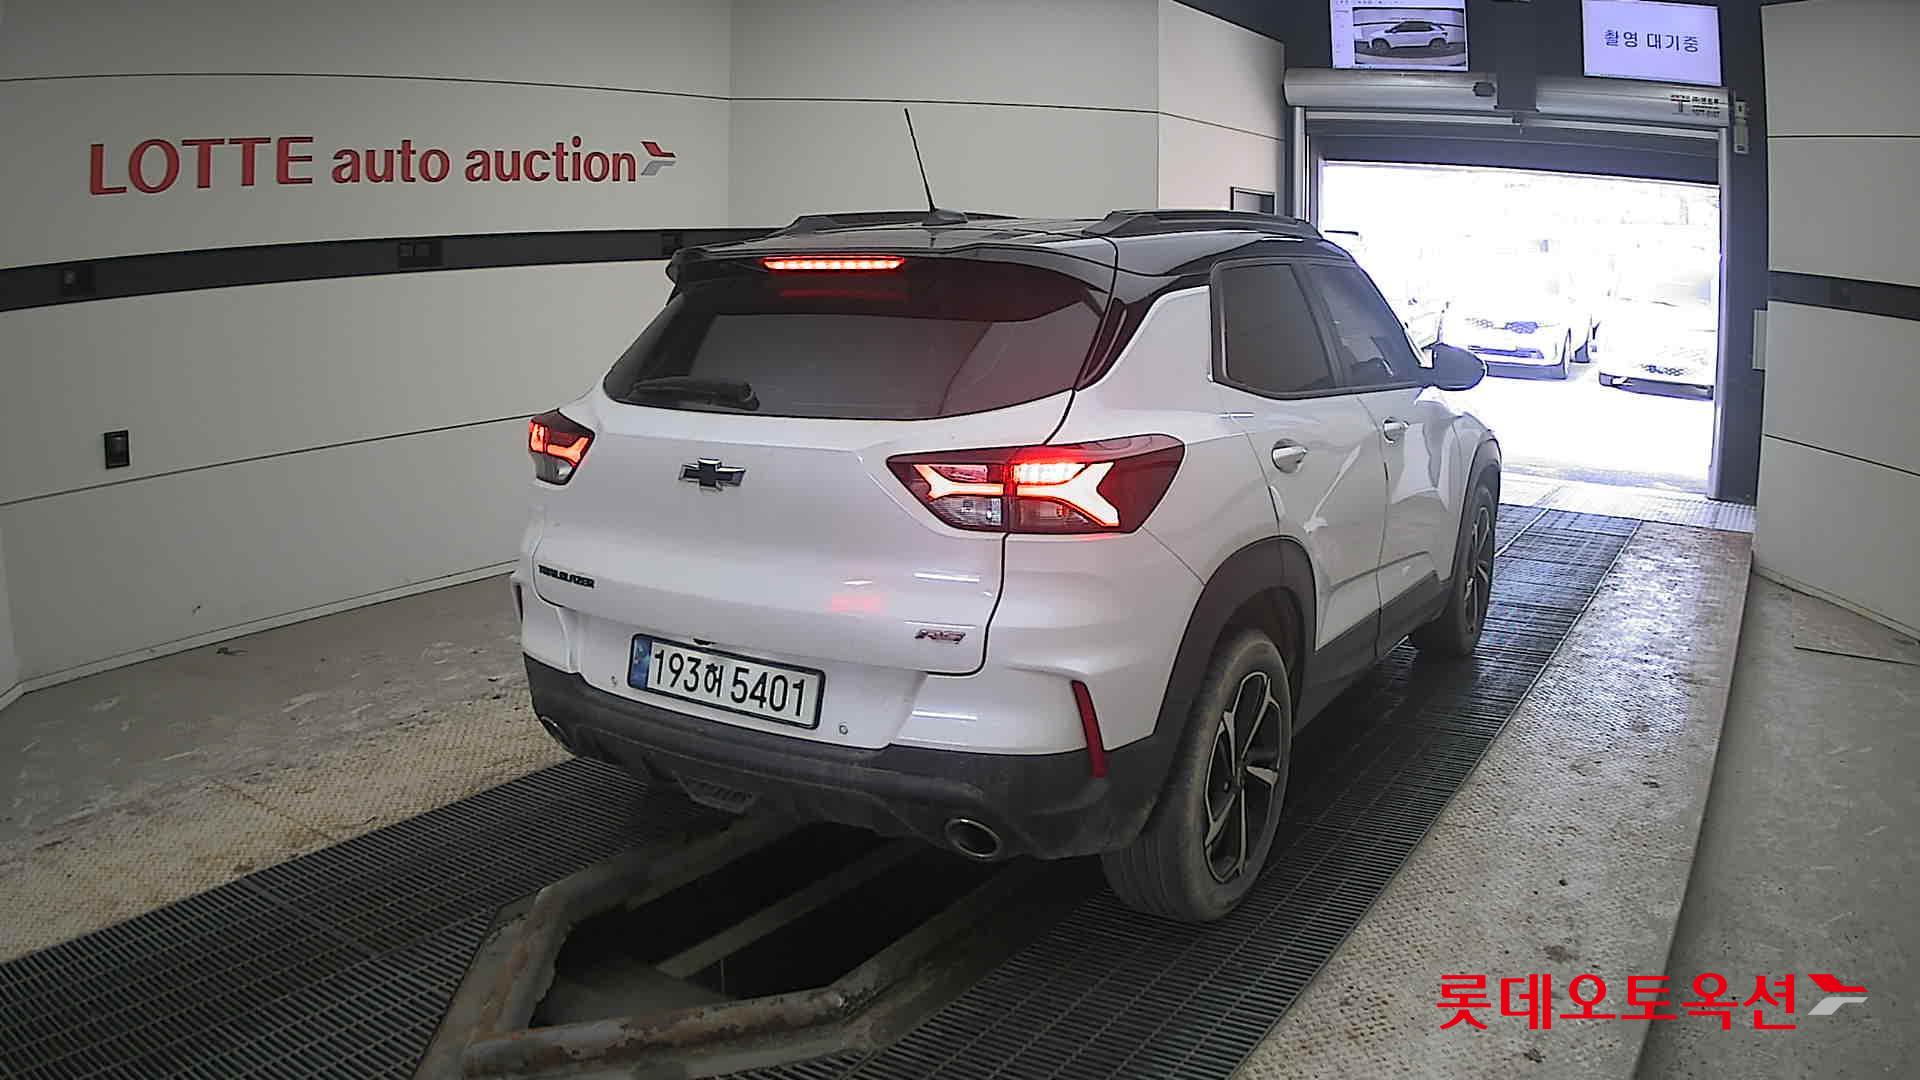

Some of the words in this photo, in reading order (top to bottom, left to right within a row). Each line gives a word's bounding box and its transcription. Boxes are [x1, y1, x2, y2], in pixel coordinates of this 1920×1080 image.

[1646, 33, 1699, 53] 대기중
[89, 136, 314, 196] LOTTE
[331, 139, 450, 184] auto
[464, 135, 637, 183] auction
[654, 649, 724, 698] 193허
[730, 666, 805, 717] 5401
